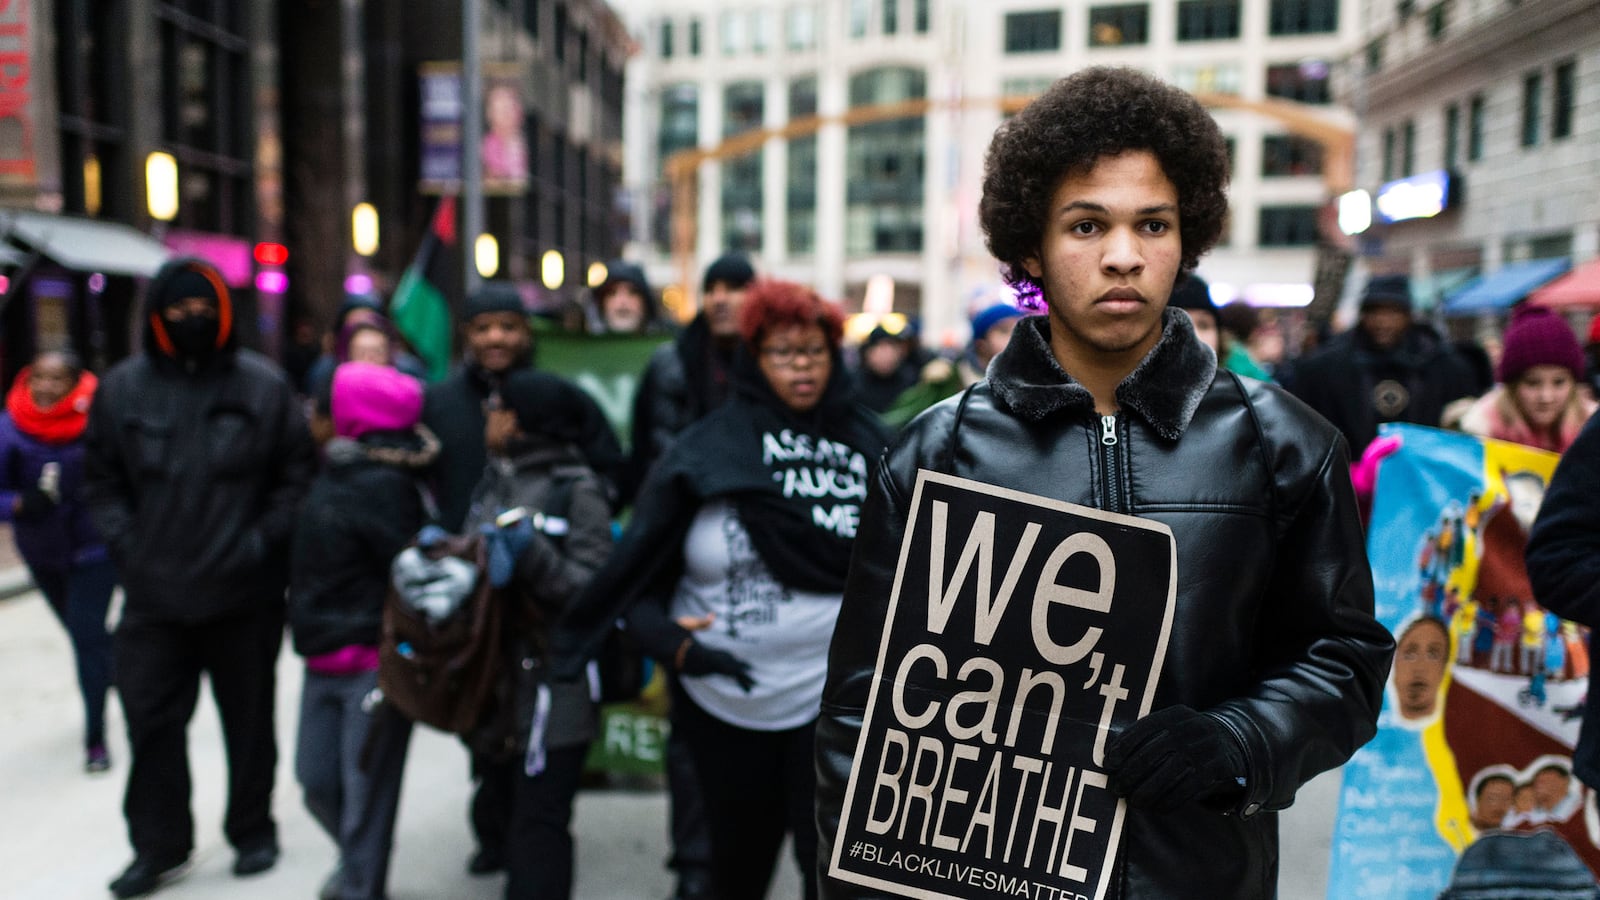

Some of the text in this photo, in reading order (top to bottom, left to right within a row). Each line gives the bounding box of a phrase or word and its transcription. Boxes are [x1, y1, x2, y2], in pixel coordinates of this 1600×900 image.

[811, 504, 860, 538] ME
[892, 643, 1129, 768] can't
[865, 728, 1110, 882] BREATHE
